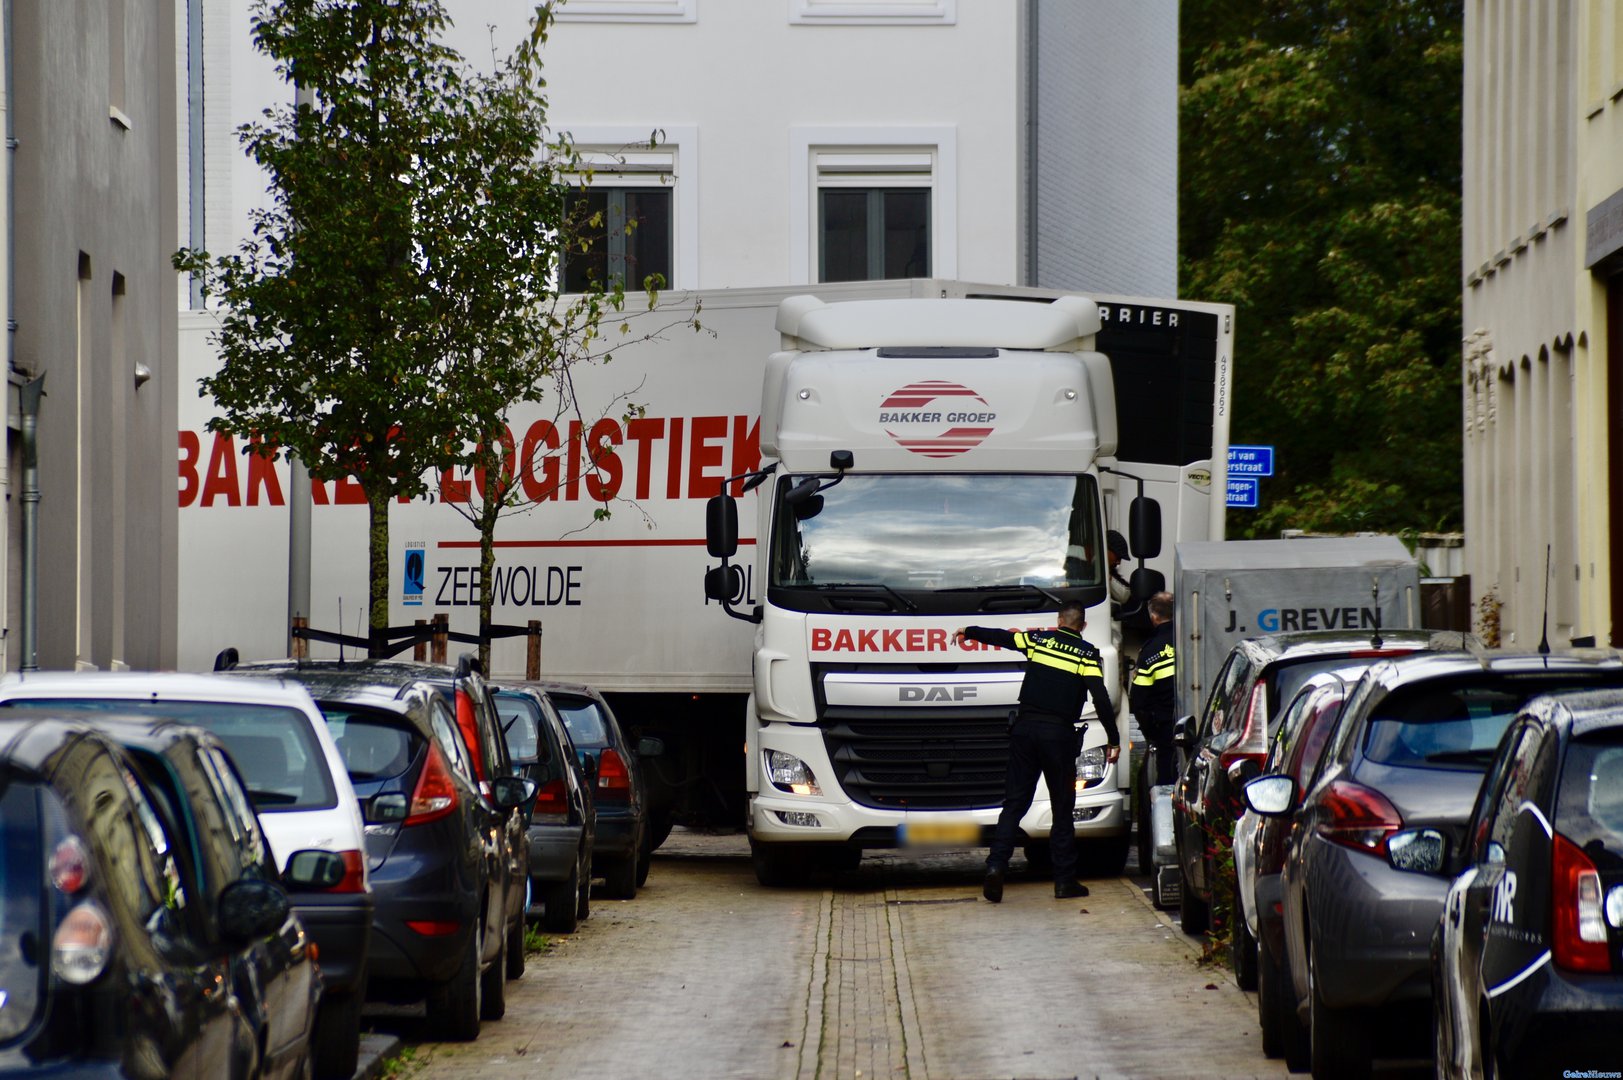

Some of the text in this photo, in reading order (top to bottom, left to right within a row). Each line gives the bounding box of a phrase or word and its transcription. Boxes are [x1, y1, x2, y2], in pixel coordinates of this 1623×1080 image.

[879, 412, 996, 423] BAKKER GROEP
[1238, 452, 1255, 460] van
[1225, 607, 1382, 632] J. GREVEN
[811, 628, 948, 652] BAKKER
[899, 686, 978, 702] DAF
